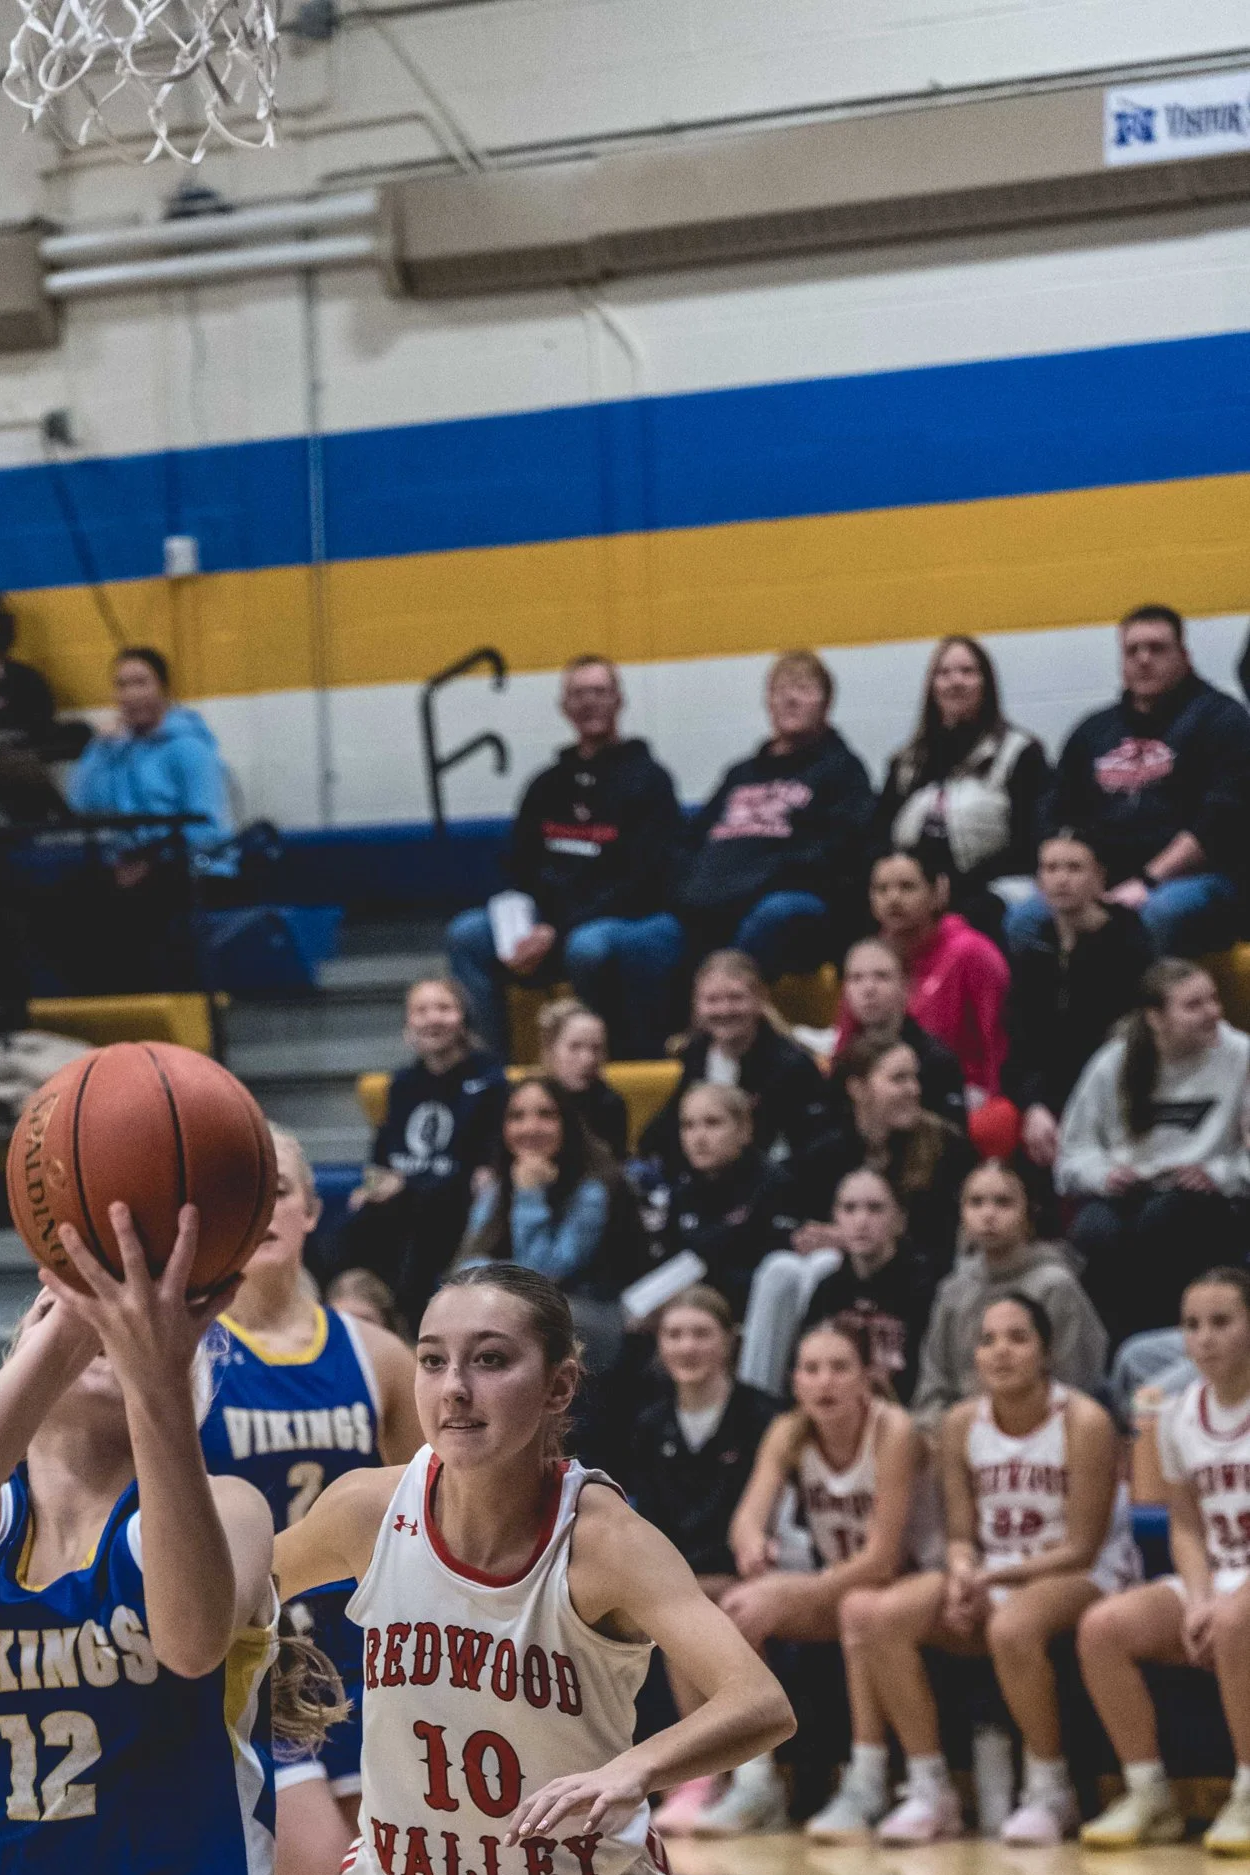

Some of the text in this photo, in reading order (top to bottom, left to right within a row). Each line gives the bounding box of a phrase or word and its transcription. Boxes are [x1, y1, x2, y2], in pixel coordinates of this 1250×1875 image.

[222, 1401, 372, 1461] VIKINGS
[366, 1621, 583, 1717] REDWOOD
[413, 1719, 527, 1819] 10
